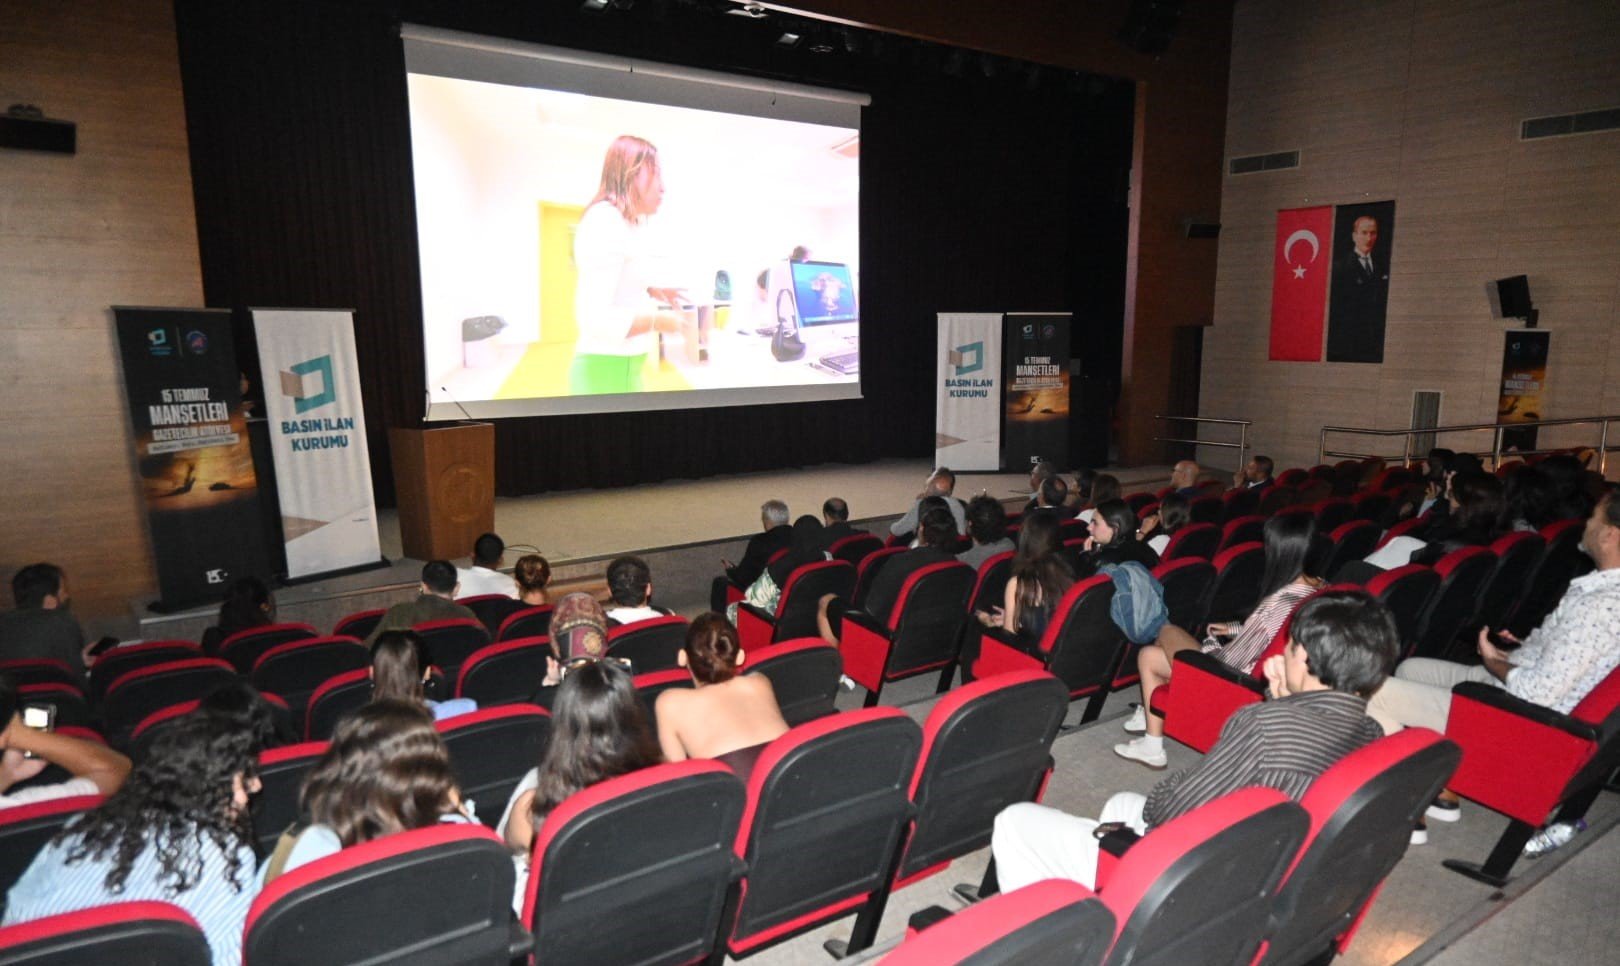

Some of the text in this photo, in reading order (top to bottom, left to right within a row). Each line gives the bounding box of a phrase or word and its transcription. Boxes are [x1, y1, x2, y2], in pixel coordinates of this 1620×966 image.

[945, 379, 971, 387] BASIN
[161, 388, 209, 402] 15 TEMMUZ
[950, 389, 988, 398] KURUMU
[281, 419, 322, 434] BASIN
[292, 435, 348, 452] KURUMU
